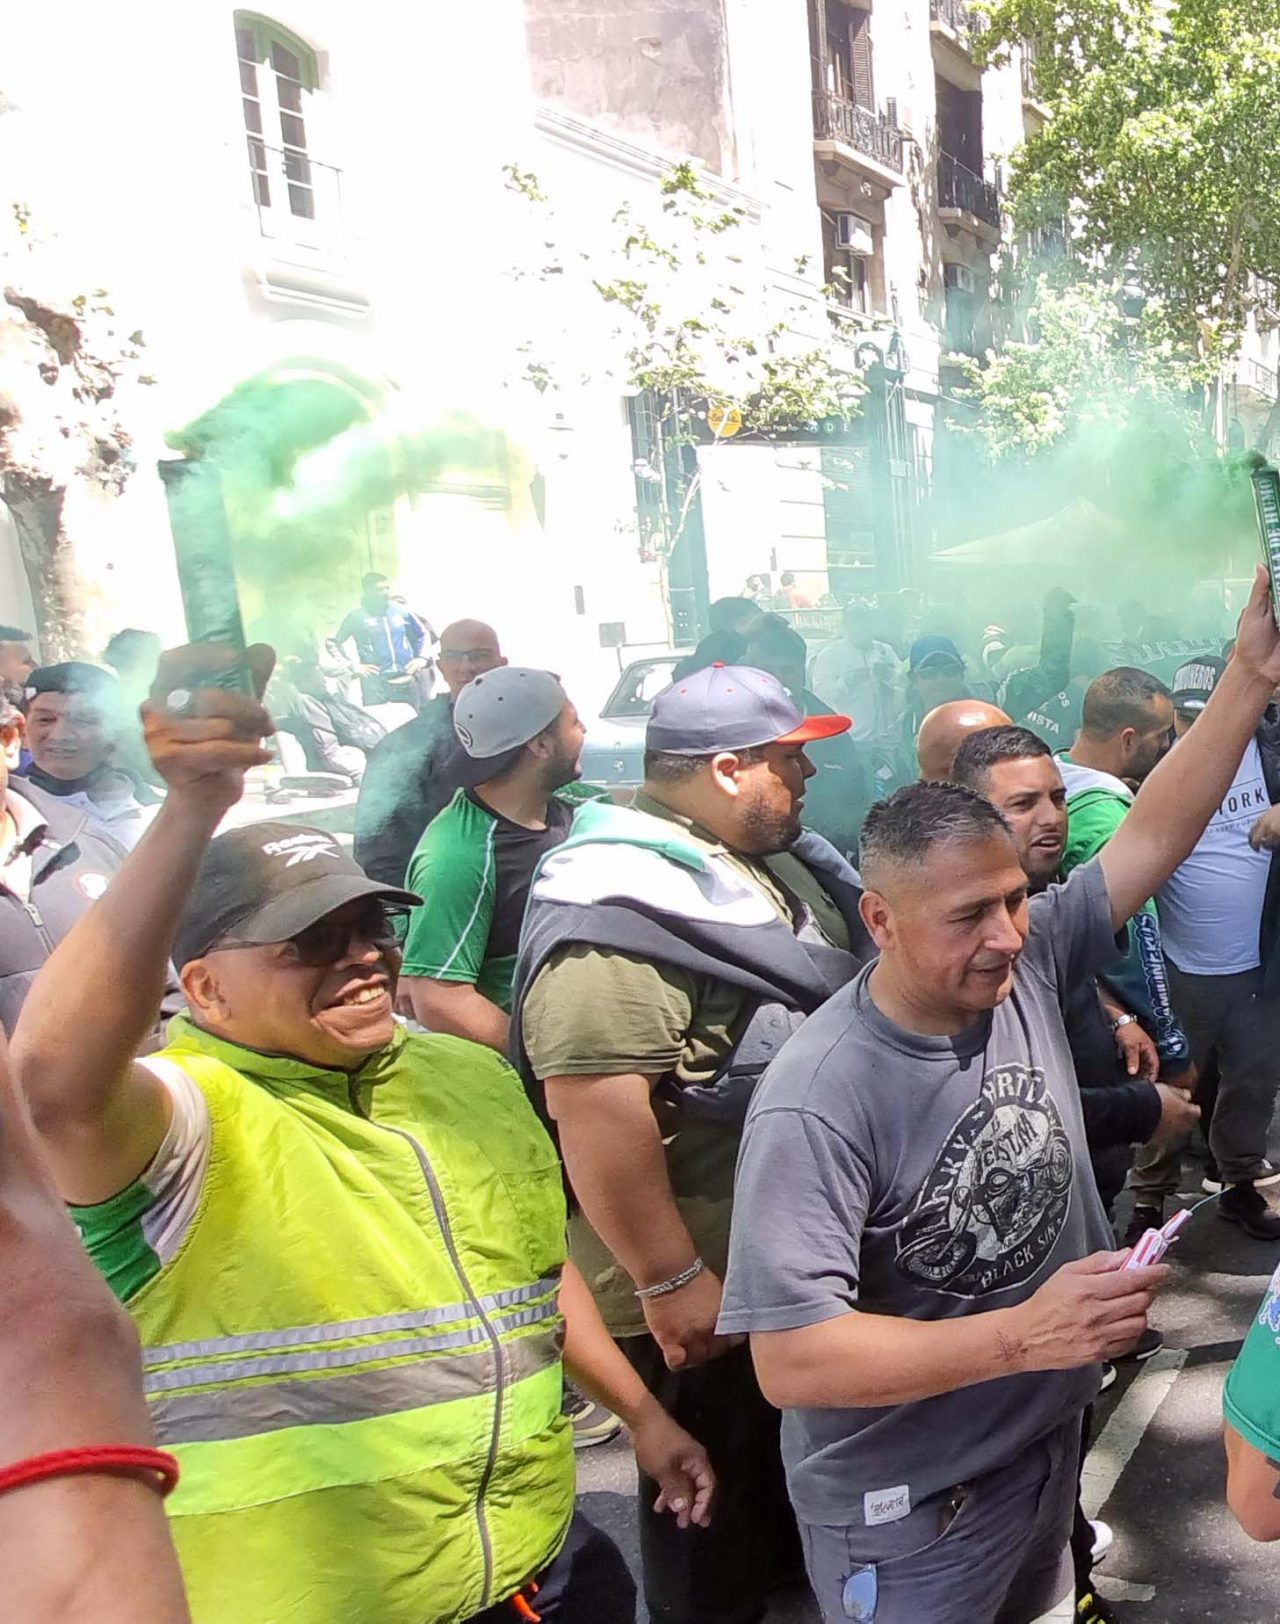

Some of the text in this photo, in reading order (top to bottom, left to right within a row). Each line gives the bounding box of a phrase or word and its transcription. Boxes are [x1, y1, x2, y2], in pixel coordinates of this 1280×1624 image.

[1258, 478, 1280, 525] HUMO
[980, 1246, 1036, 1289] BLACK
[1036, 1226, 1057, 1251] SIN
